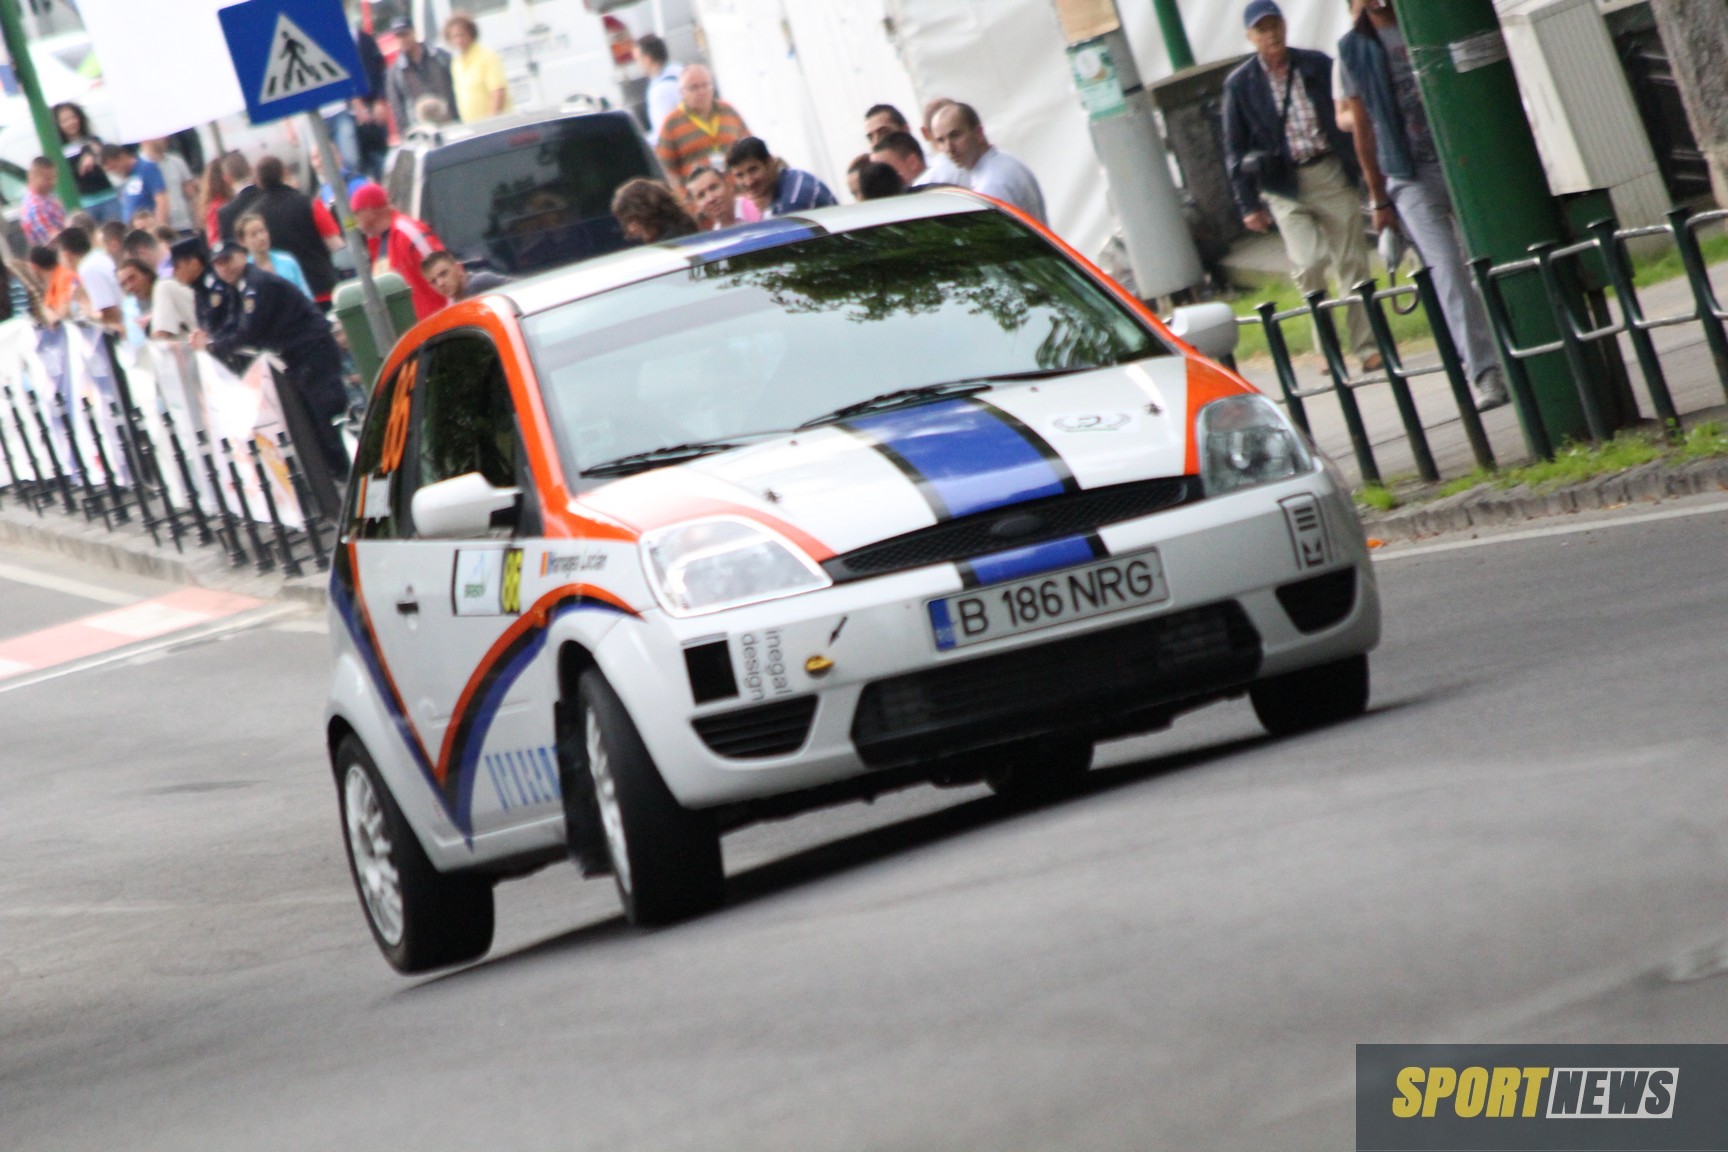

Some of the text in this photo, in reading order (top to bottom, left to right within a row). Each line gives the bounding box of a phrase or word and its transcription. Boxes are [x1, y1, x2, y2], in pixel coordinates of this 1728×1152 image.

[957, 560, 1153, 637] B 186 NRG
[741, 633, 765, 701] design
[764, 628, 793, 695] inegal
